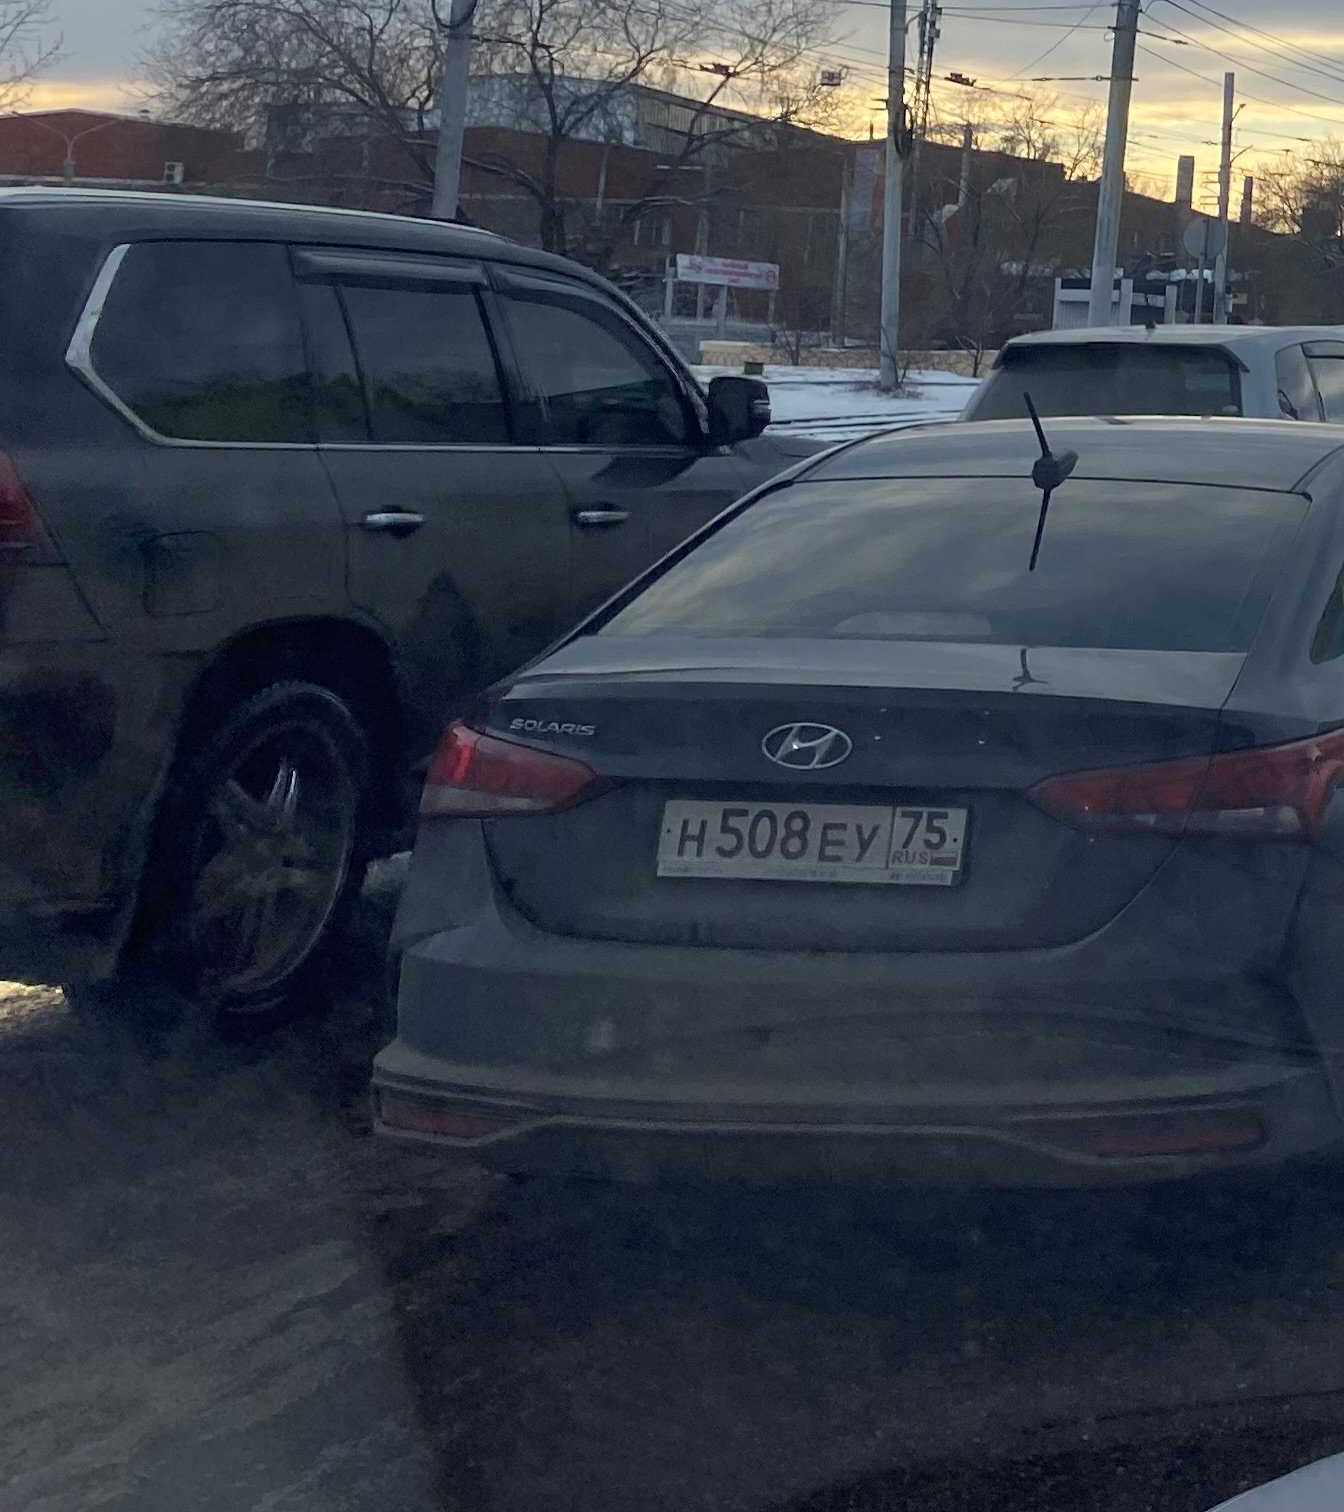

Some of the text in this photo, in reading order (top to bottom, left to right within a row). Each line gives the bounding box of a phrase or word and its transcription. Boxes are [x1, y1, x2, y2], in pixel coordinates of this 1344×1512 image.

[510, 718, 595, 736] SOLARIS
[900, 810, 949, 850] 75
[891, 850, 930, 866] RUS
